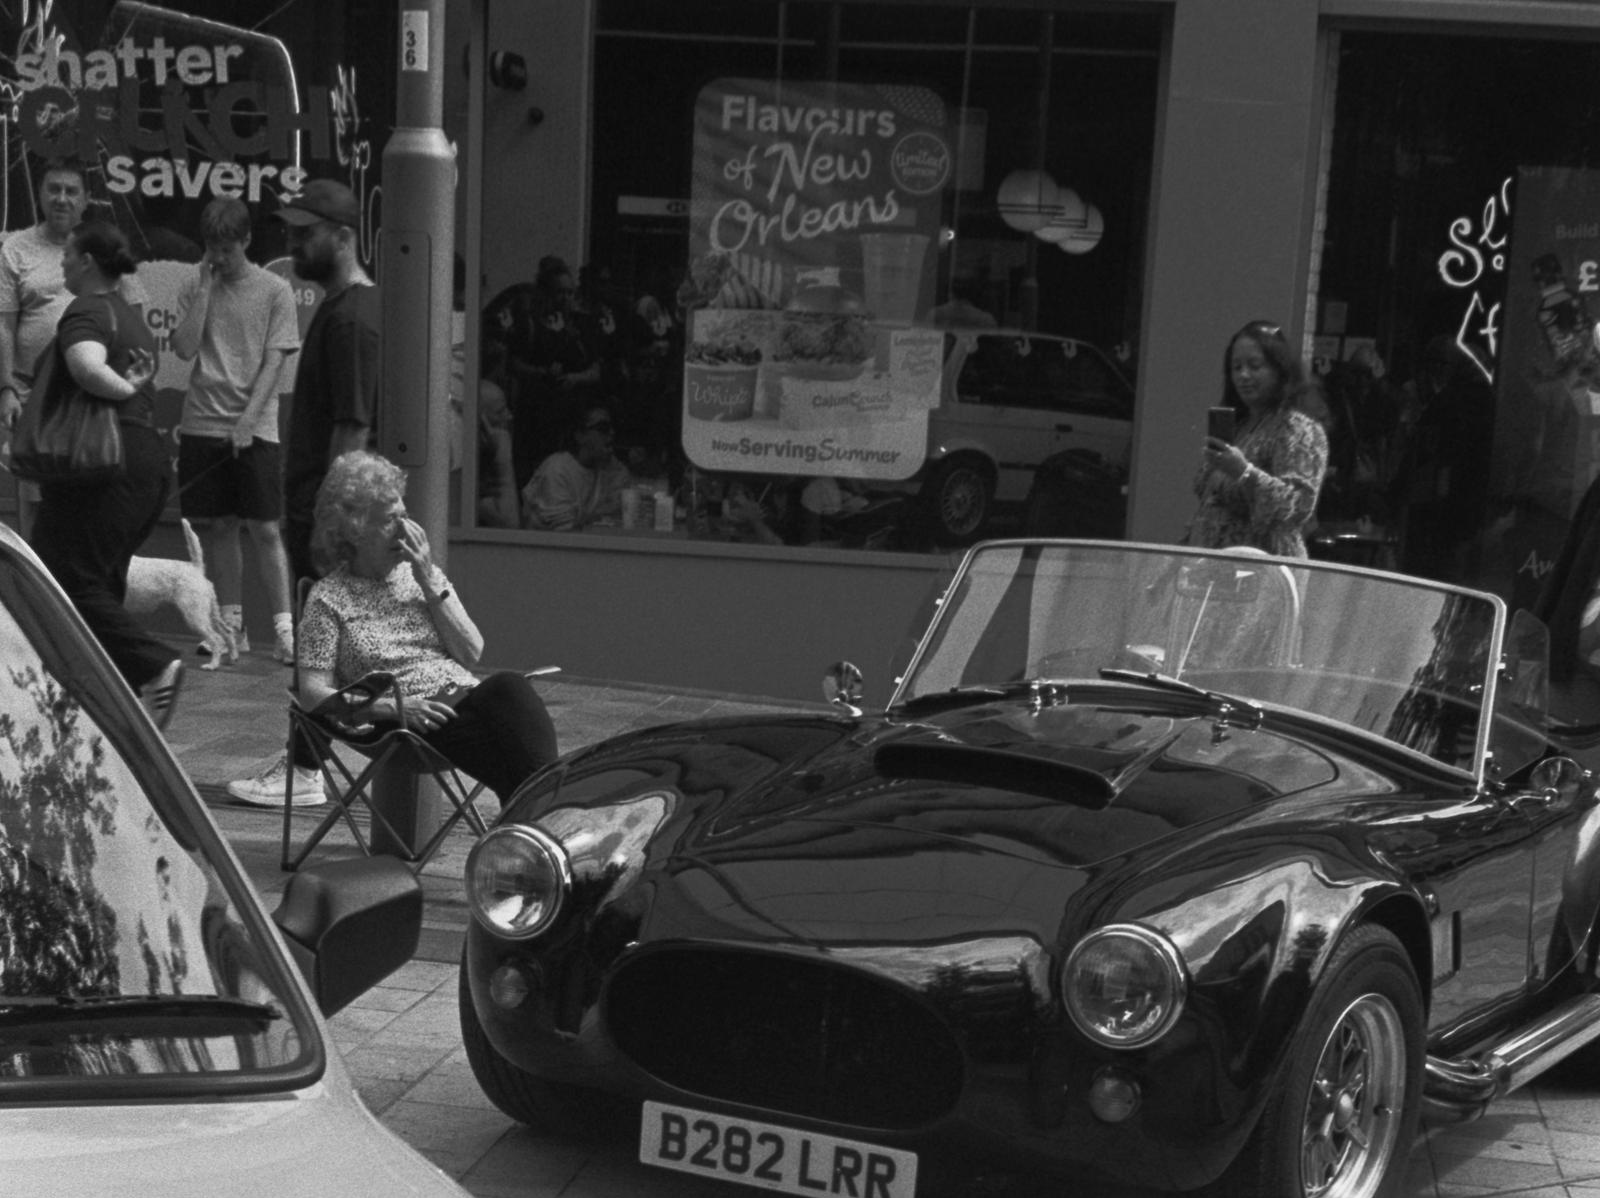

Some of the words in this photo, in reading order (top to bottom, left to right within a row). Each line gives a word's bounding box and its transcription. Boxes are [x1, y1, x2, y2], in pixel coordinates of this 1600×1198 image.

[15, 36, 244, 89] shatter
[722, 95, 896, 137] Flavours
[105, 155, 309, 204] savers
[723, 146, 757, 190] of
[764, 120, 871, 202] New
[710, 190, 898, 253] Orleans
[739, 437, 817, 462] Serving
[817, 438, 901, 464] Summer
[658, 1111, 785, 1182] B282
